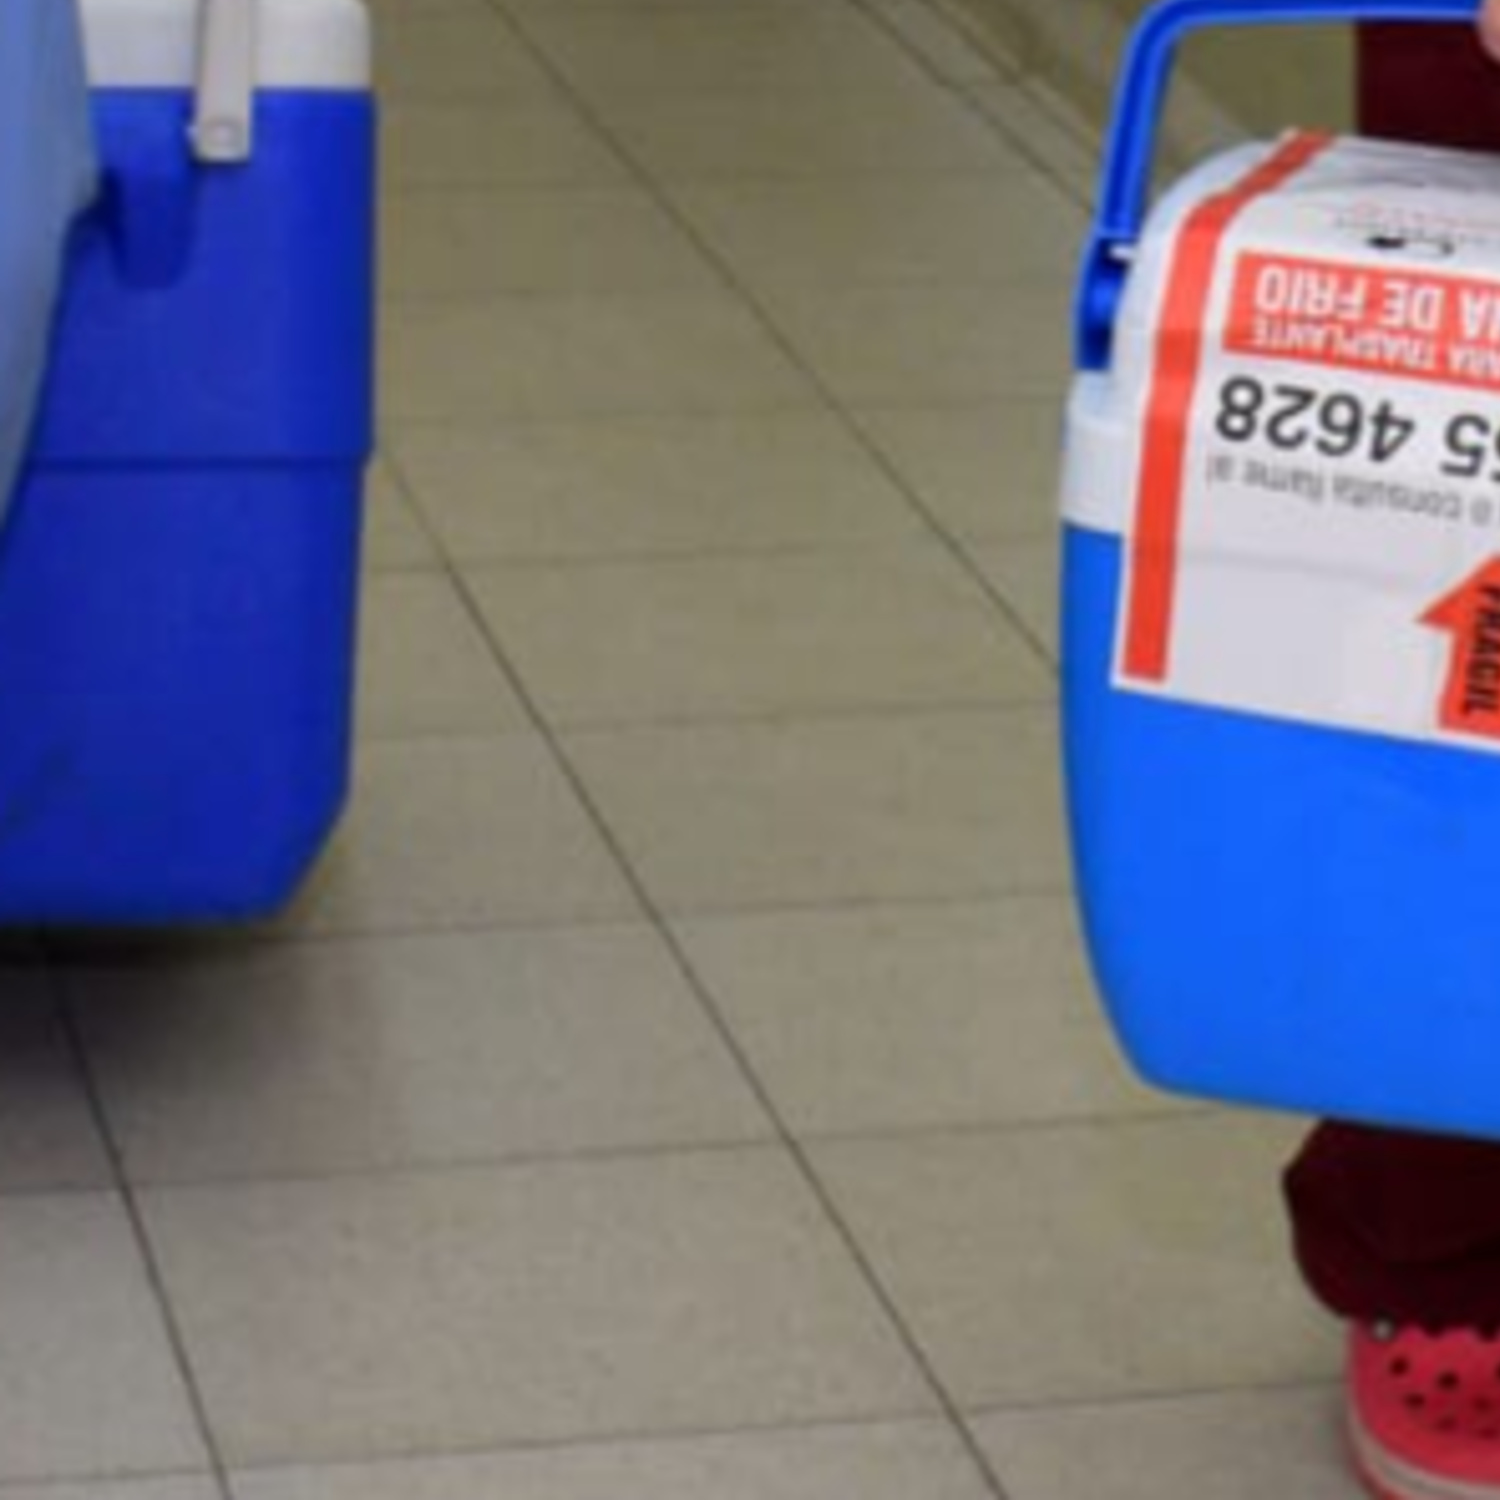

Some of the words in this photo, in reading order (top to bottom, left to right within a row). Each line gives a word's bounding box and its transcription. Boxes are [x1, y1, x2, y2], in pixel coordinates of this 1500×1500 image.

[1254, 263, 1370, 321] FRIO
[1380, 280, 1445, 331] DE
[1215, 373, 1416, 463] 4628
[1332, 471, 1462, 520] consulta
